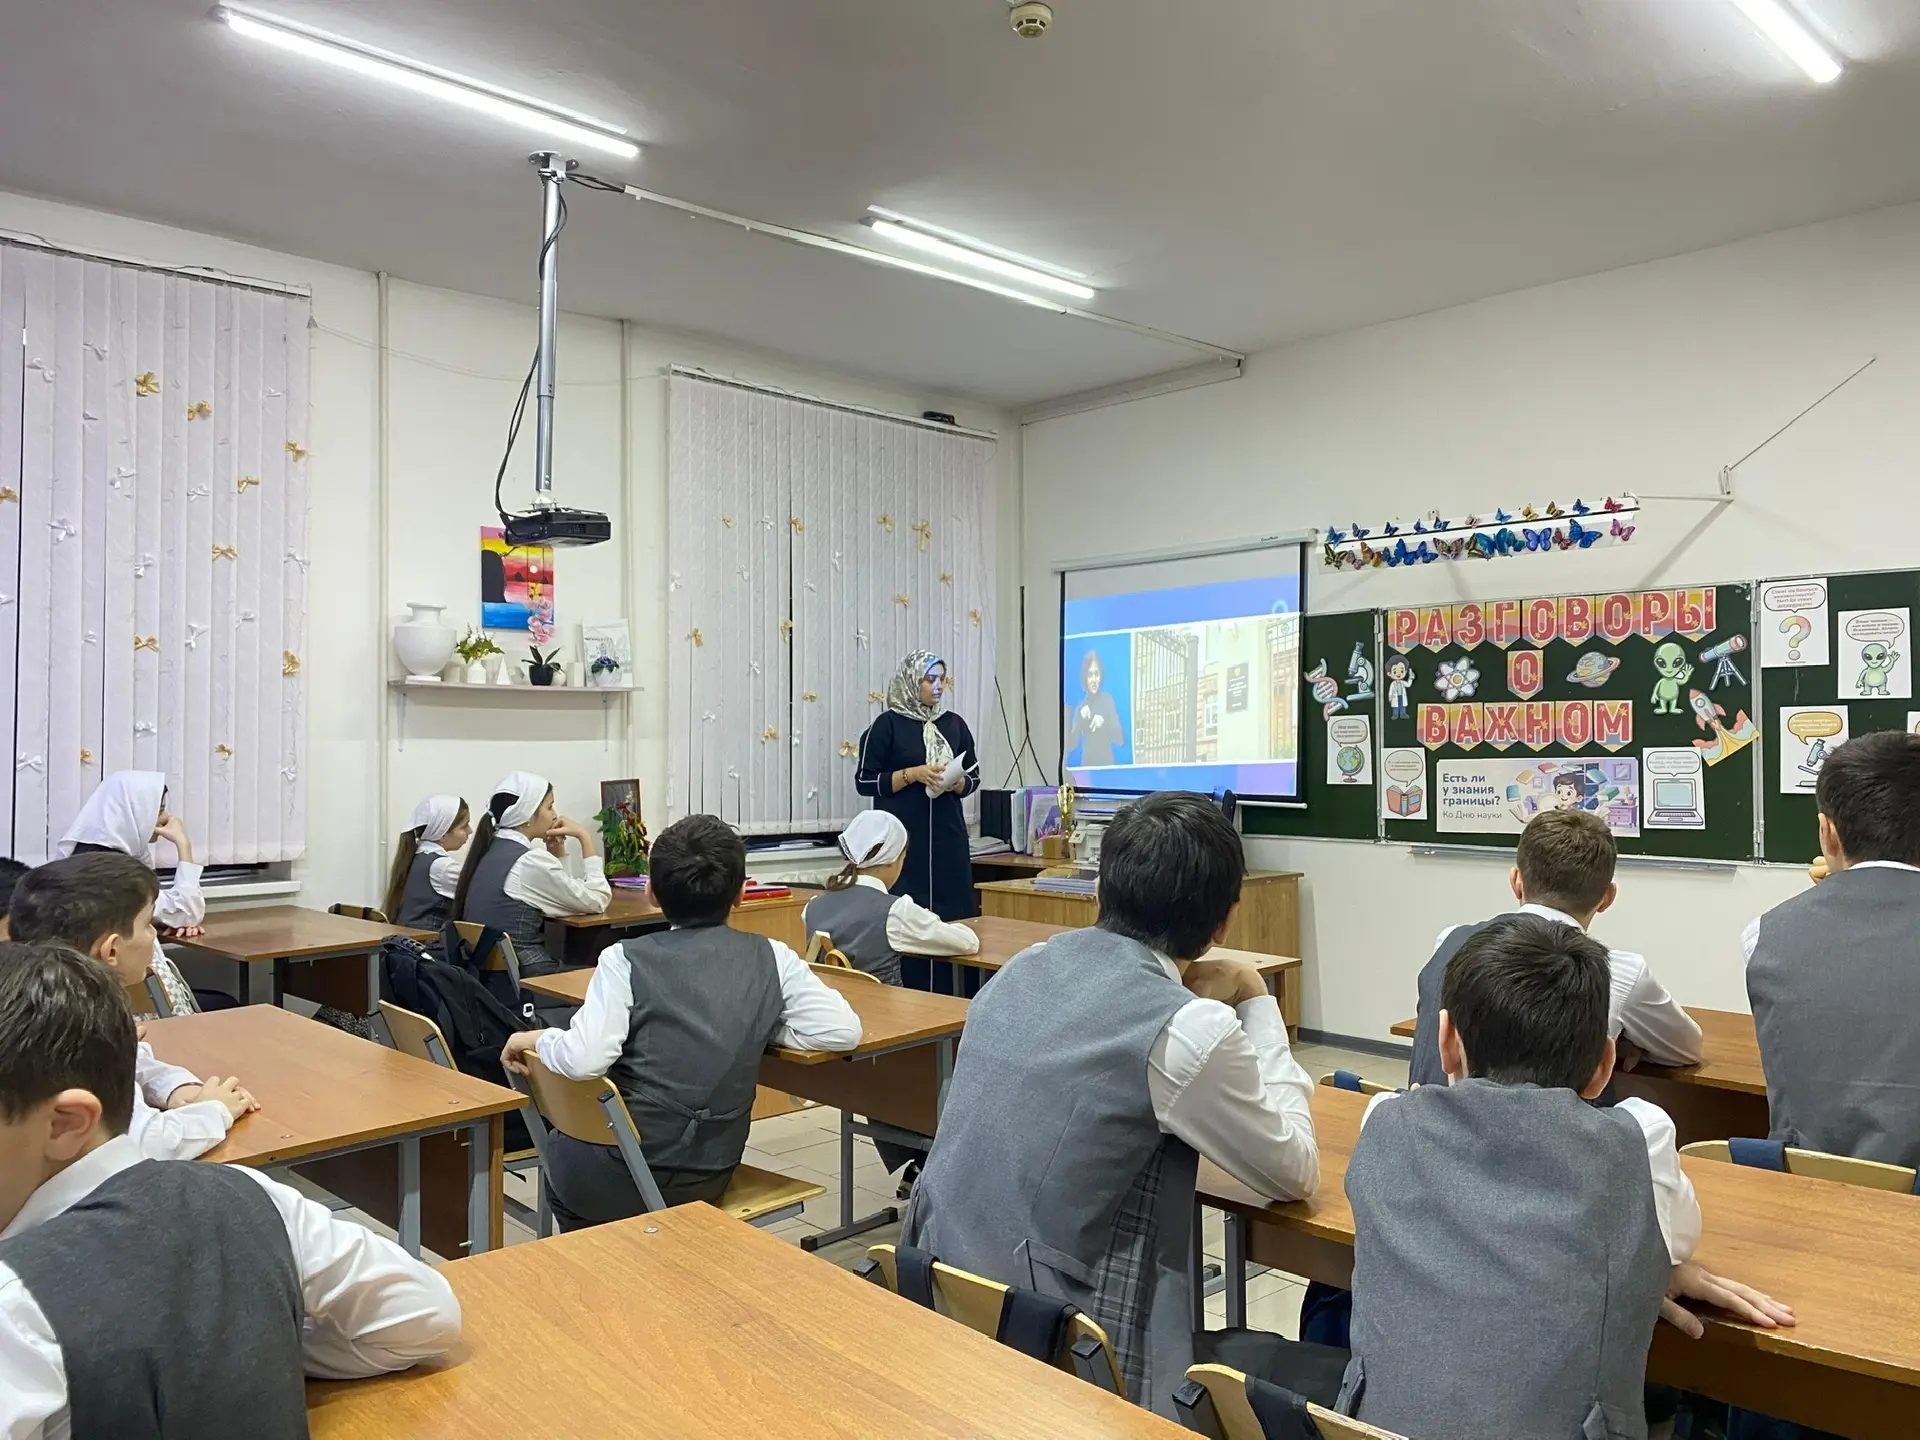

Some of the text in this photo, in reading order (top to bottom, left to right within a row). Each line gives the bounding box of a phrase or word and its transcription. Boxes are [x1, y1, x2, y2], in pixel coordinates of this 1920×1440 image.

[1395, 587, 1716, 648] РАЗГОВОРЫ
[1512, 651, 1540, 693] О
[1423, 701, 1632, 745] ВАЖНОМ
[1443, 773, 1468, 782] Есть
[1442, 786, 1494, 796] у знания
[1443, 796, 1501, 807] границы?
[1443, 810, 1502, 820] Ко Дню науки
